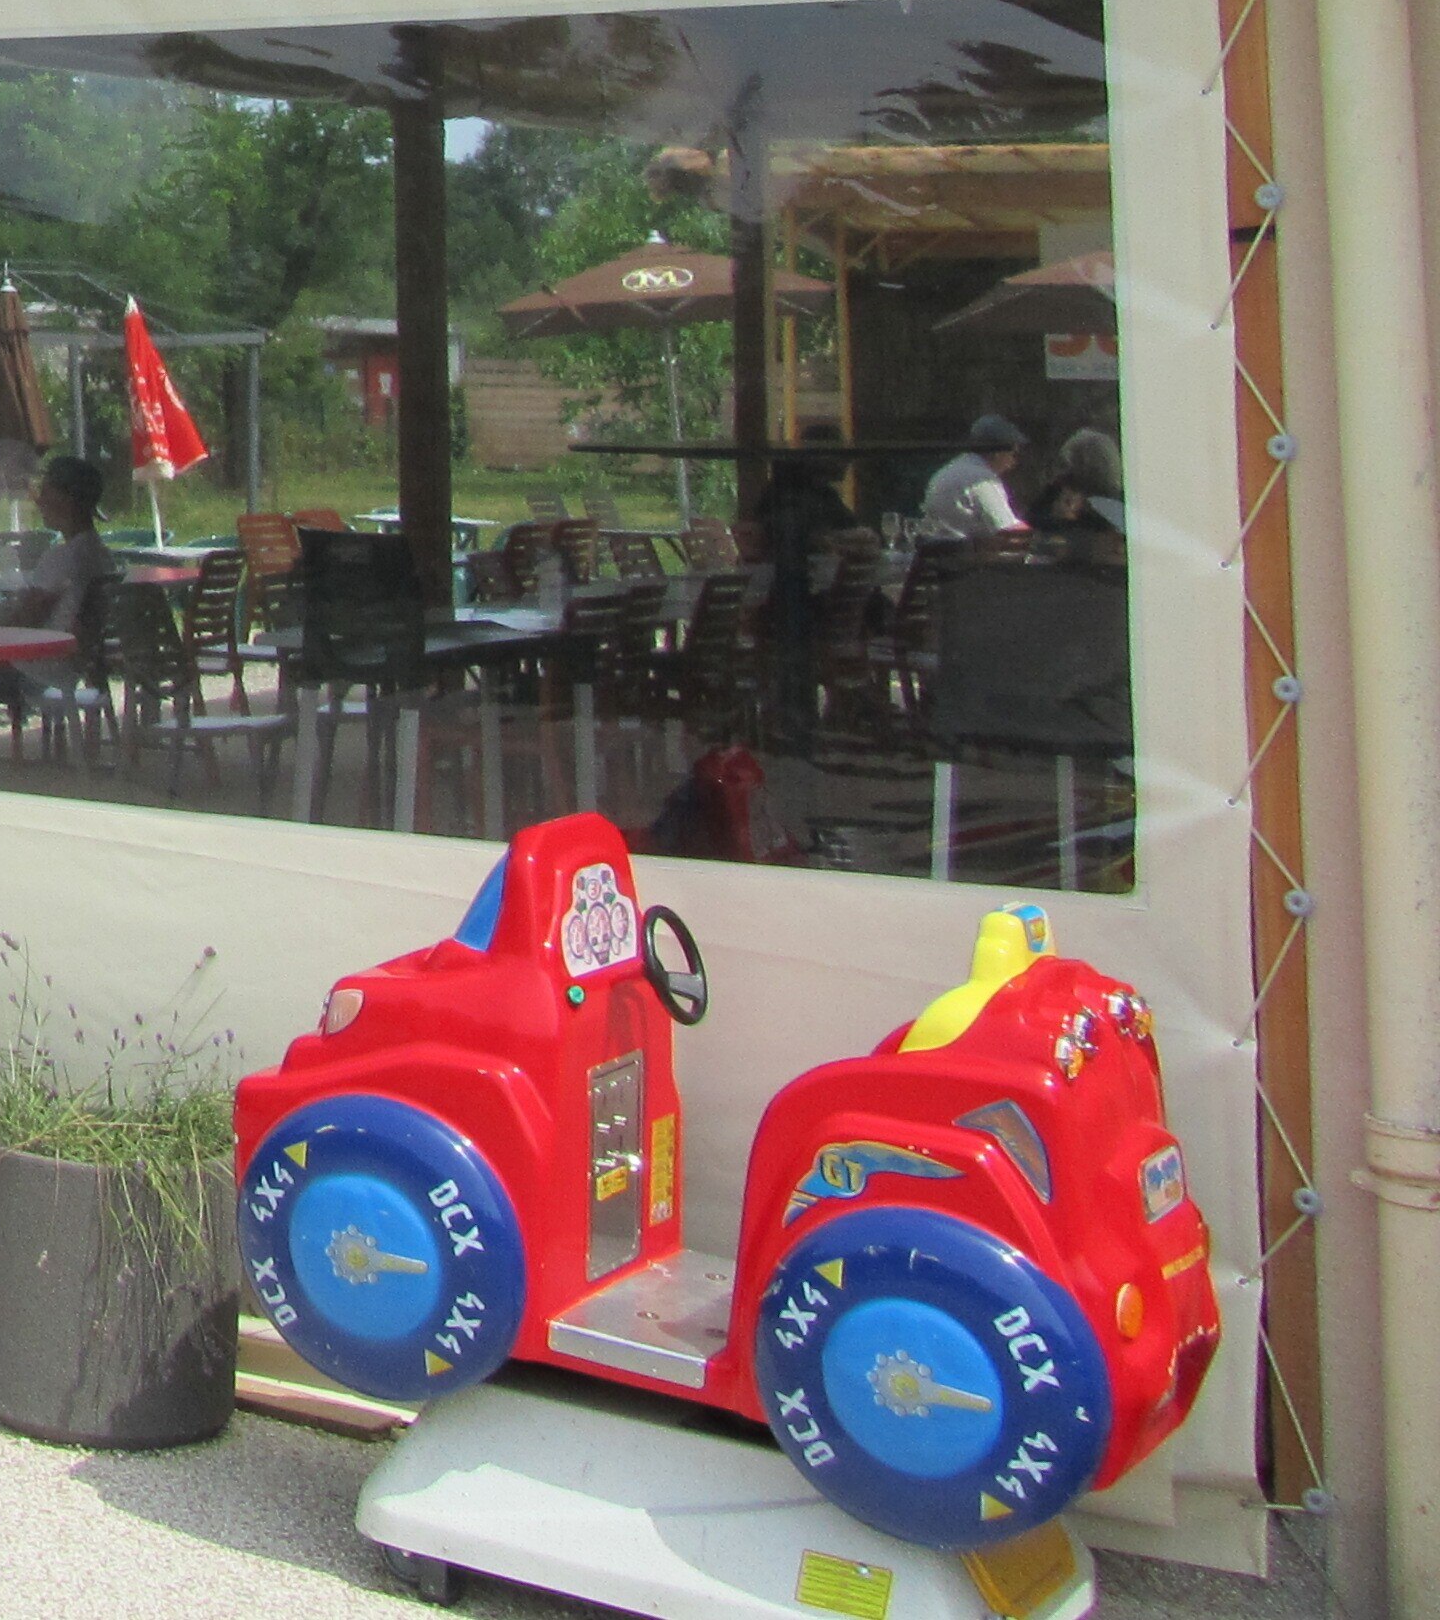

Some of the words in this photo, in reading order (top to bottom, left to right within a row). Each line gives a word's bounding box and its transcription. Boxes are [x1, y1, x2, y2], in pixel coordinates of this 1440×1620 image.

[820, 1152, 863, 1193] GT
[428, 1178, 485, 1258] DCX
[251, 1255, 299, 1328] DCX
[992, 1305, 1062, 1393] DCX
[774, 1387, 836, 1468] DCX
